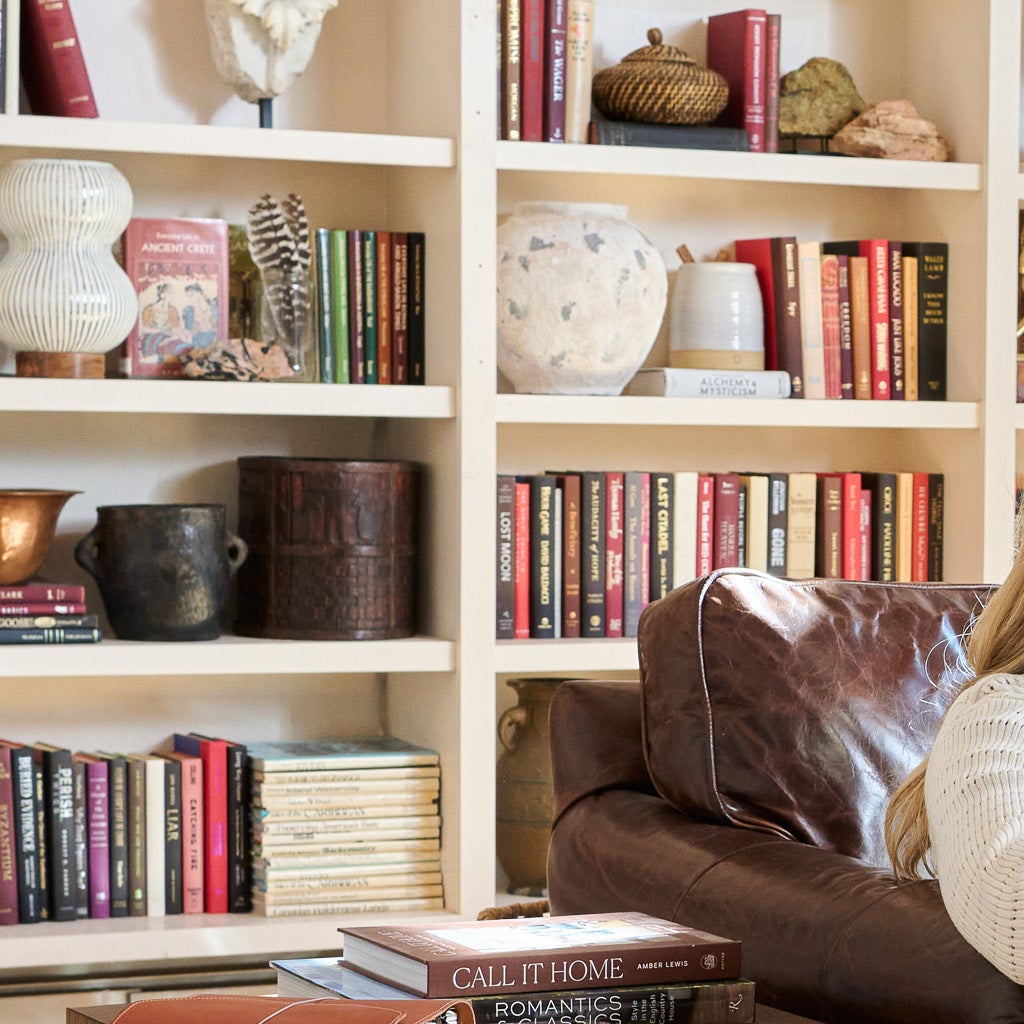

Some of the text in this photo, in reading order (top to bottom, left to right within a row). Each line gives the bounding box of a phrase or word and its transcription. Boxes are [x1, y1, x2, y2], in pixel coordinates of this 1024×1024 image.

[553, 40, 564, 101] The WAGER
[142, 243, 215, 254] ANCIENT CRETE
[893, 272, 902, 307] LUCADO
[700, 387, 756, 396] MYSTICISM
[701, 377, 749, 386] ALCHEMY
[657, 478, 668, 555] LAST CITADEL
[883, 486, 892, 514] CIRCE
[500, 512, 511, 541] LOST
[591, 495, 599, 542] AUDACITY
[629, 517, 637, 533] The
[501, 543, 511, 581] MOON
[539, 486, 551, 605] HOUR GAME DAVID BALDACCI
[771, 528, 785, 566] GONE
[591, 555, 599, 581] HOPE
[18, 756, 33, 798] BURIED
[59, 768, 74, 819] PERISH
[20, 800, 35, 852] EVIDENCE
[167, 809, 179, 841] LIAR
[452, 957, 624, 990] CALL IT HOME
[637, 960, 688, 970] AMBER LEWIS
[495, 996, 622, 1018] ROMANTICS
